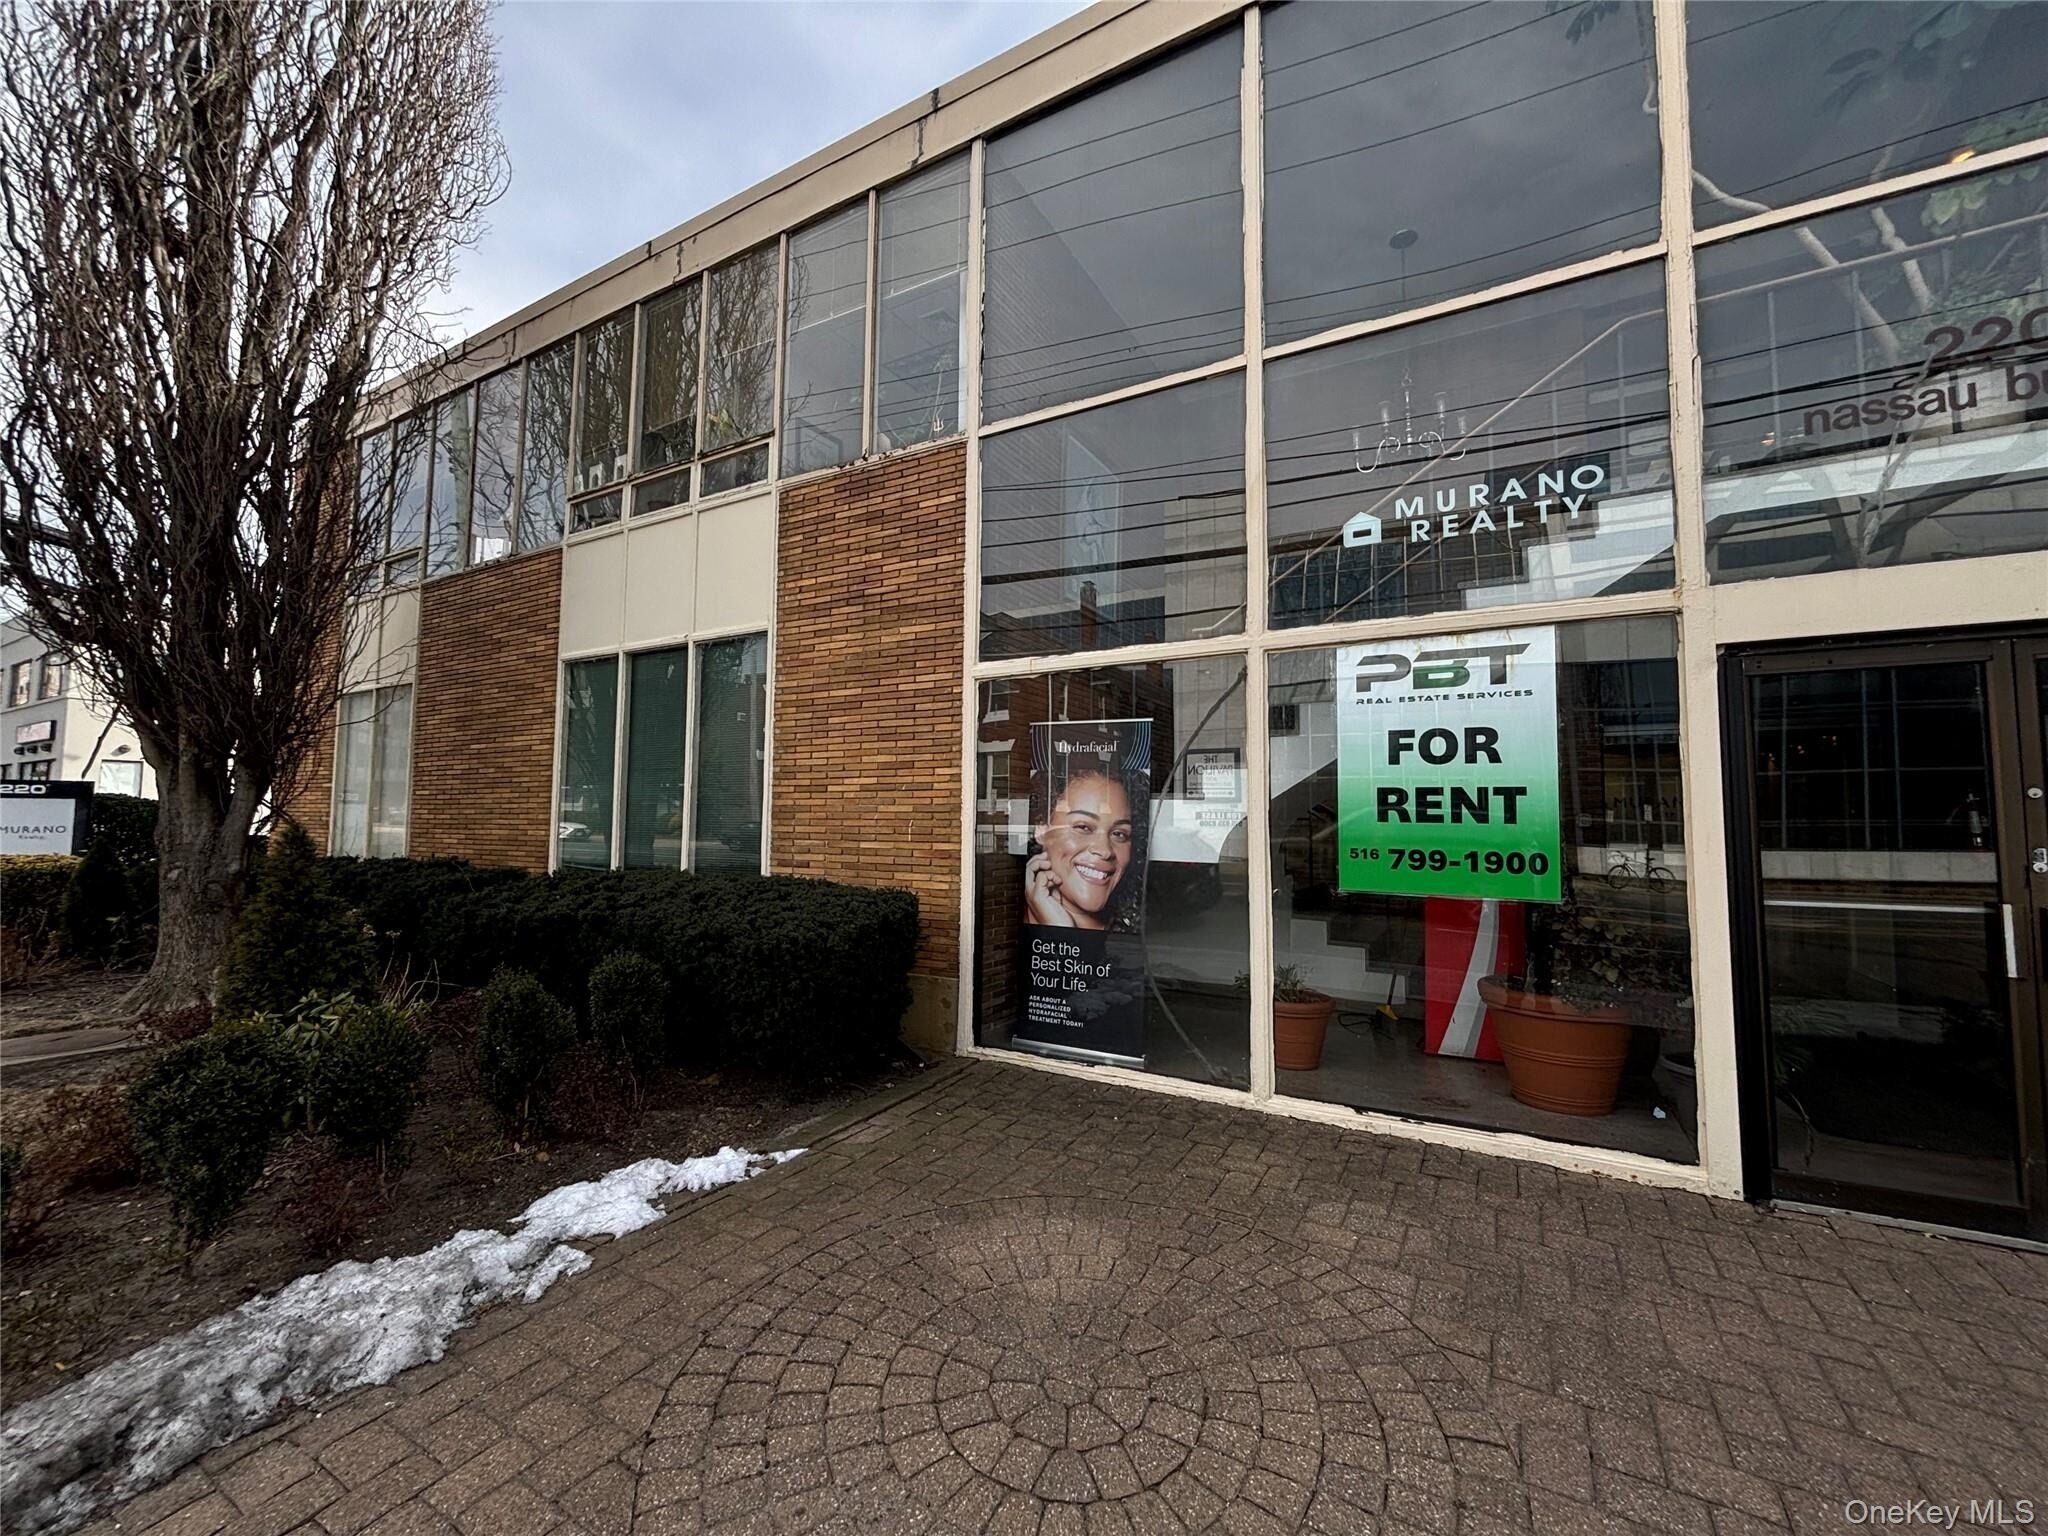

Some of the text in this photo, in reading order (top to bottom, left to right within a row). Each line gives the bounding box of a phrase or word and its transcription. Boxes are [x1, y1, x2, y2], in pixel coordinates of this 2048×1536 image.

[1803, 381, 1978, 436] nassau
[1395, 464, 1605, 520] MURANO
[1410, 494, 1587, 543] REALTY
[1356, 643, 1531, 693] PBT
[1356, 689, 1533, 705] REAL ESTATE SERVICES
[1387, 726, 1502, 765] FOR
[0, 784, 46, 794] 220
[1376, 786, 1528, 825] RENT
[1350, 848, 1549, 876] 516 799-1900
[1032, 939, 1081, 957] Get the
[1031, 955, 1112, 978] Best Skin of
[1031, 972, 1089, 993] Your Life.
[1029, 1001, 1071, 1012] PERSONALIZED
[1042, 996, 1061, 1004] ABOUT
[1028, 1008, 1067, 1019] HYDRAFACIAL
[1028, 1014, 1084, 1028] TREATMENT TODAY!
